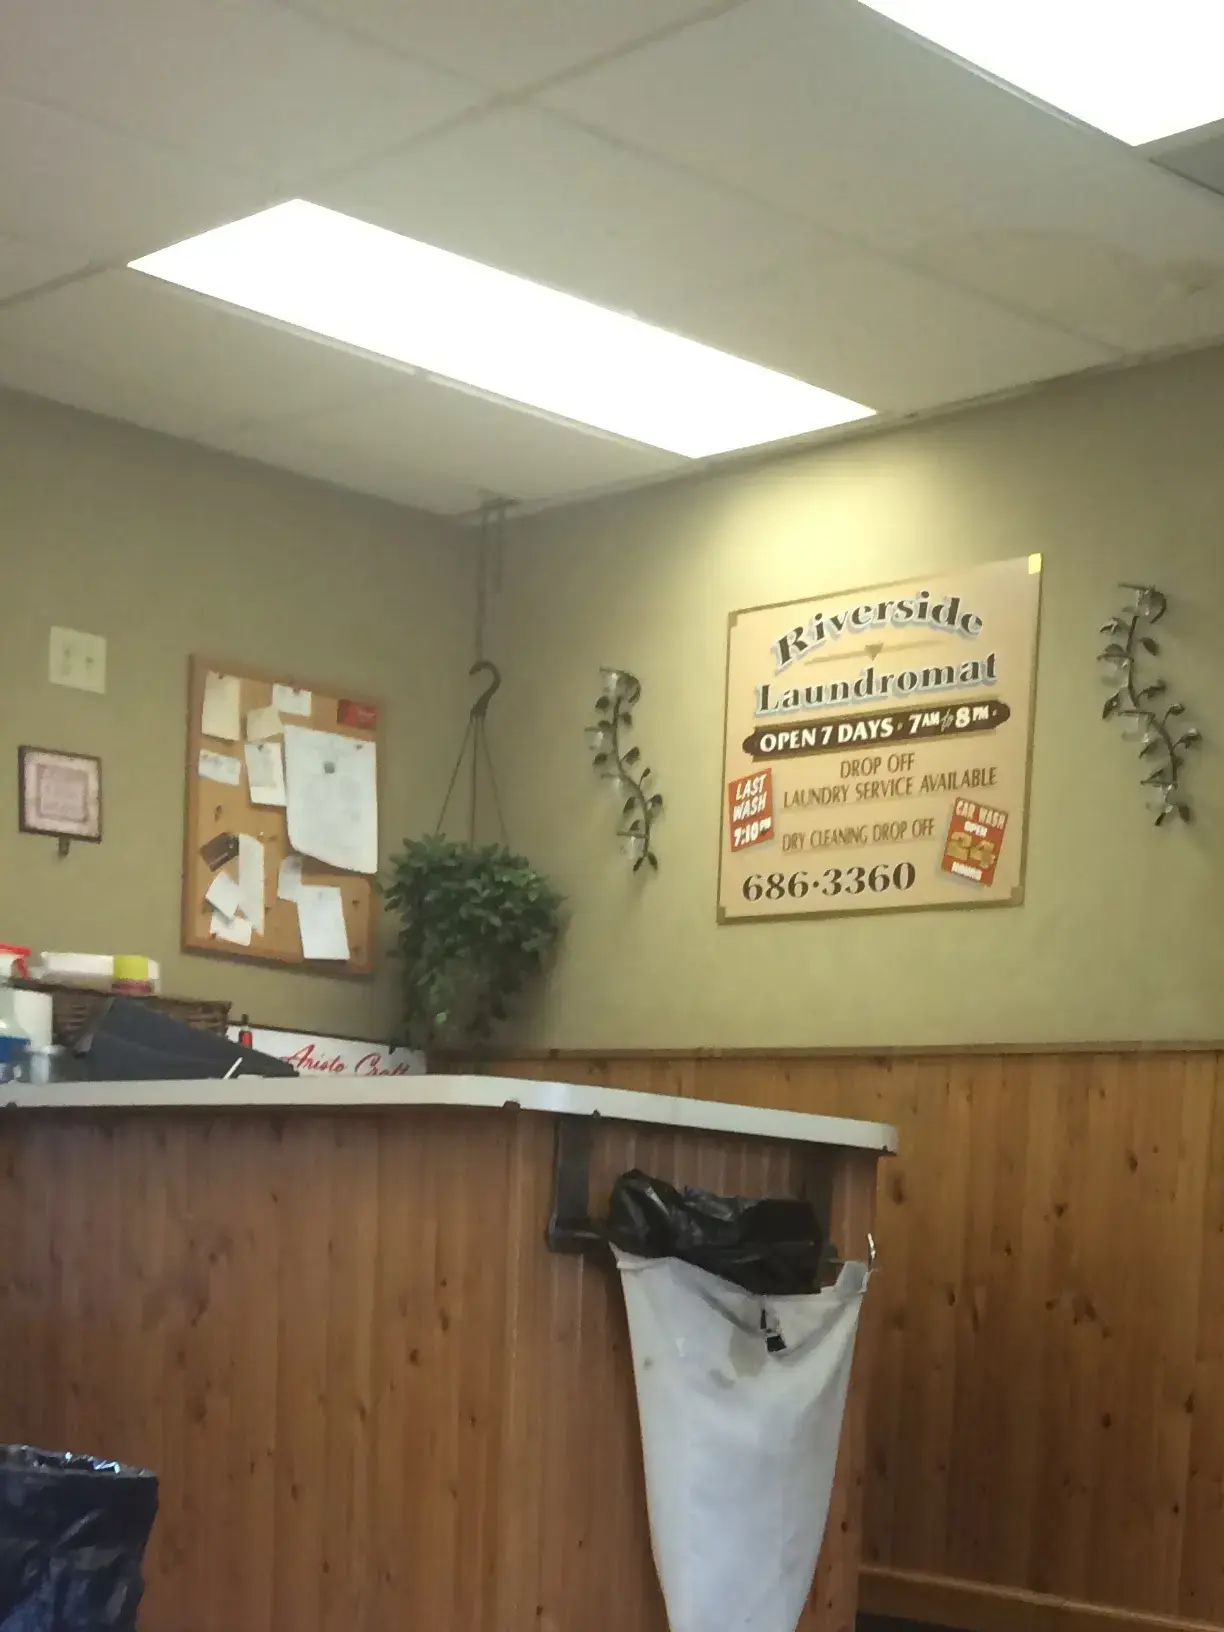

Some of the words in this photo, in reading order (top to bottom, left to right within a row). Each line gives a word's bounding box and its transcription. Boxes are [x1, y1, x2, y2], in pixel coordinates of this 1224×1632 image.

[774, 590, 985, 670] Riverside
[757, 653, 997, 715] Laundromat
[759, 727, 816, 752] OPEN
[821, 726, 831, 745] 7
[837, 717, 894, 744] DAYS
[840, 756, 882, 779] DROP
[887, 752, 915, 773] OFF
[735, 773, 767, 801] LAST
[783, 784, 849, 808] LAUNDRY
[855, 776, 913, 801] SERVICE
[919, 766, 997, 793] AVAILABLE
[732, 791, 767, 822] WASH
[956, 800, 976, 820] CAR
[979, 807, 1006, 829] WASH
[782, 832, 806, 852] DRY
[810, 823, 868, 848] CLEANING
[872, 820, 910, 842] DROP
[911, 818, 936, 839] OFF
[946, 831, 996, 869] 24
